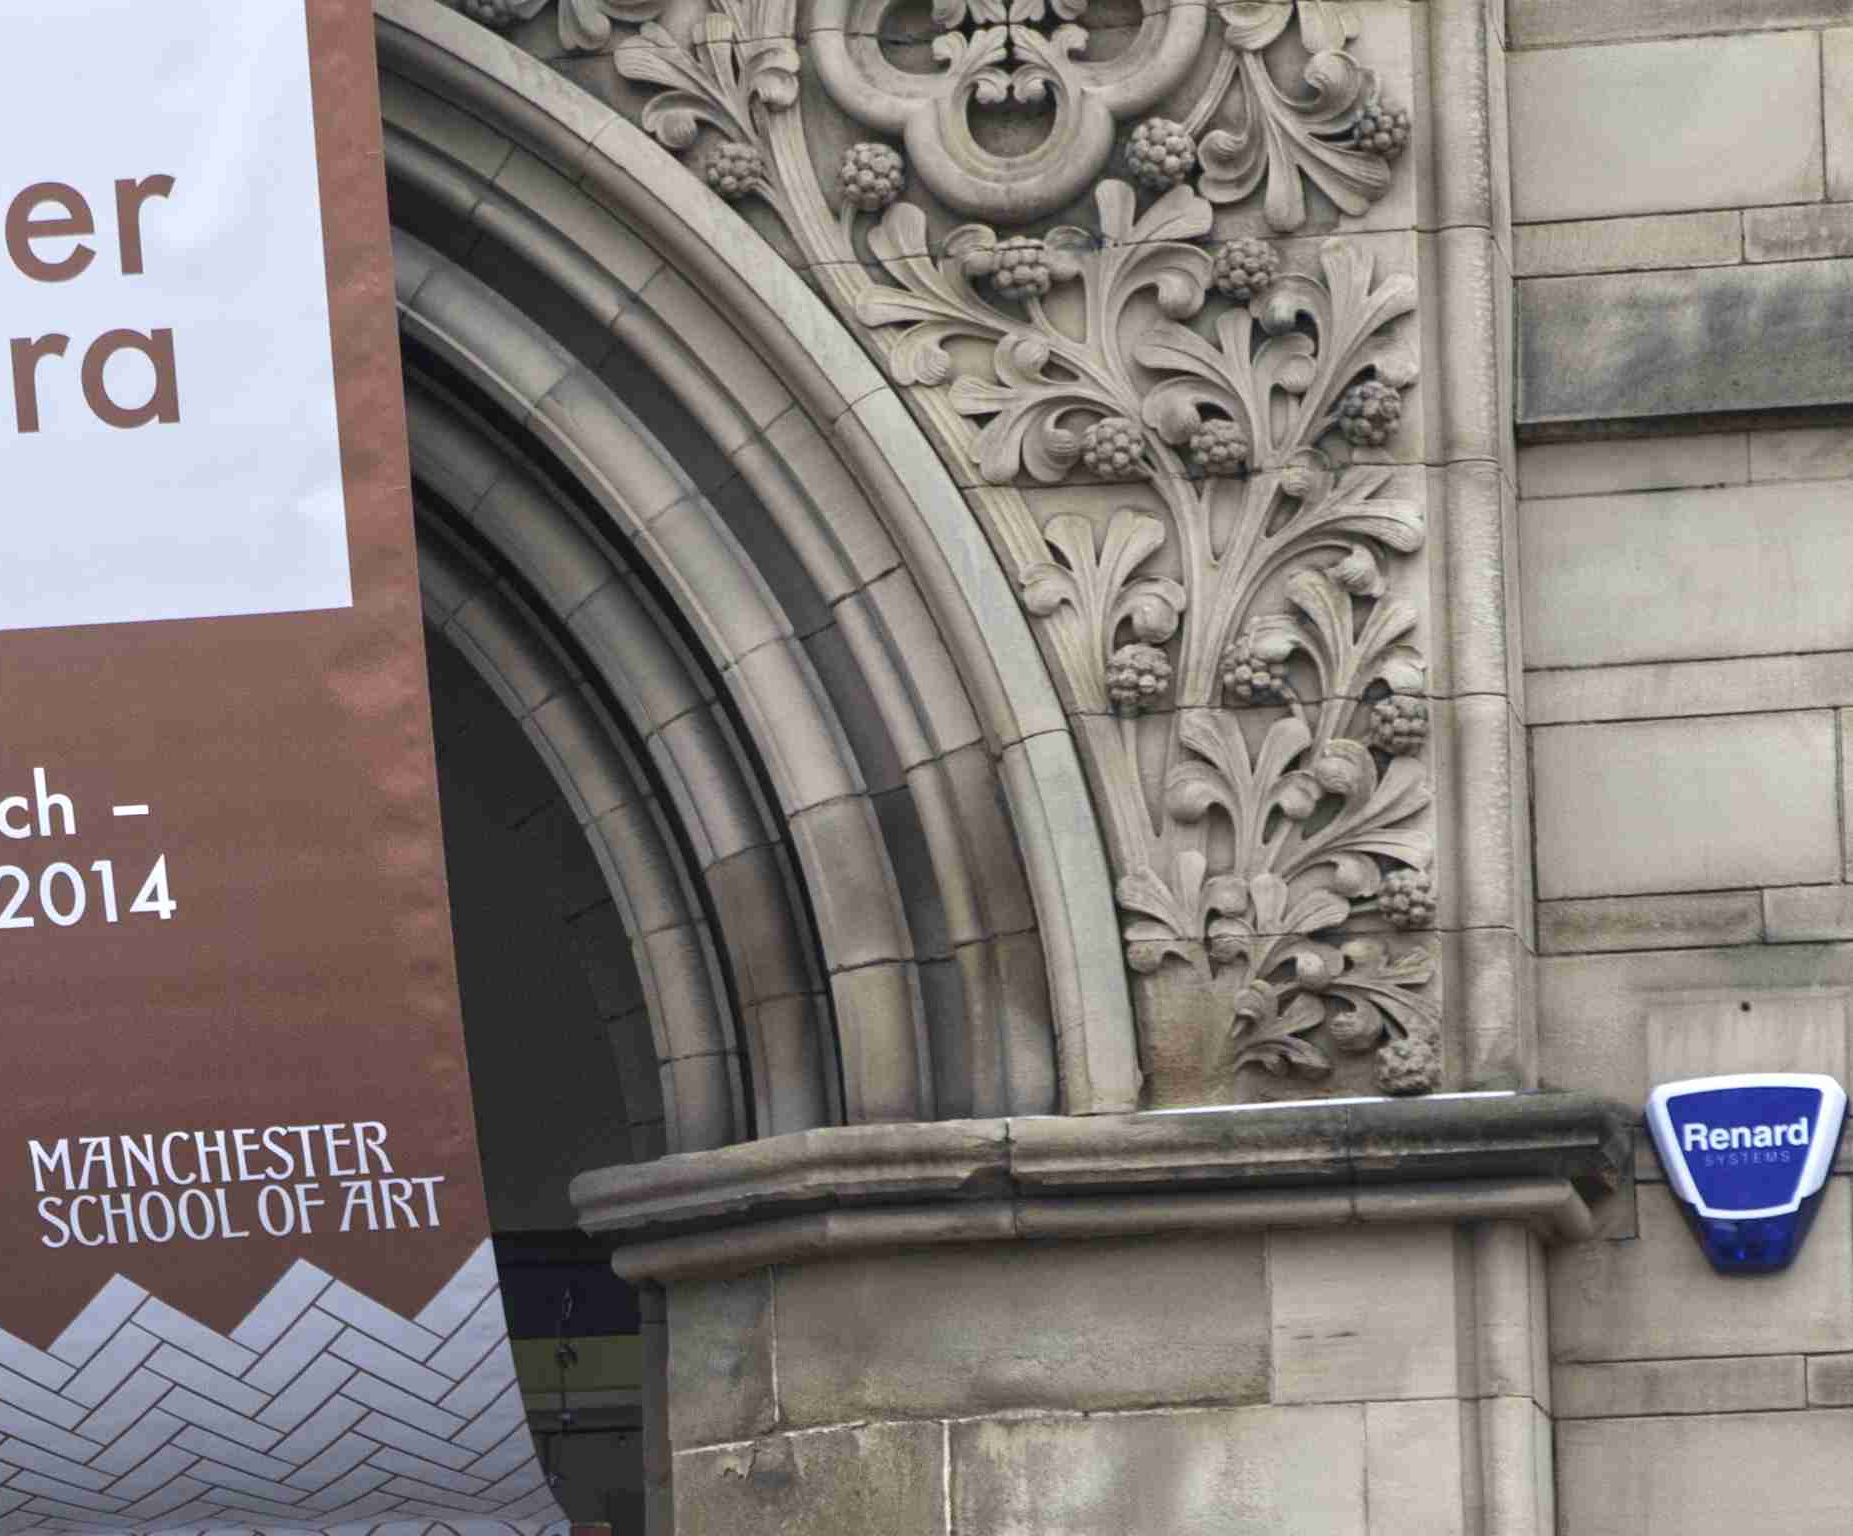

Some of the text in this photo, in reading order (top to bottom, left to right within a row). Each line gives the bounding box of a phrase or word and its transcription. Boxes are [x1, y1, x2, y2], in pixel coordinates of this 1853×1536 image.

[27, 1120, 395, 1193] MANCHESTER
[1683, 1116, 1810, 1152] Renard
[1703, 1150, 1792, 1168] SYSTEMS
[37, 1174, 446, 1249] SCHOOL OF ART
